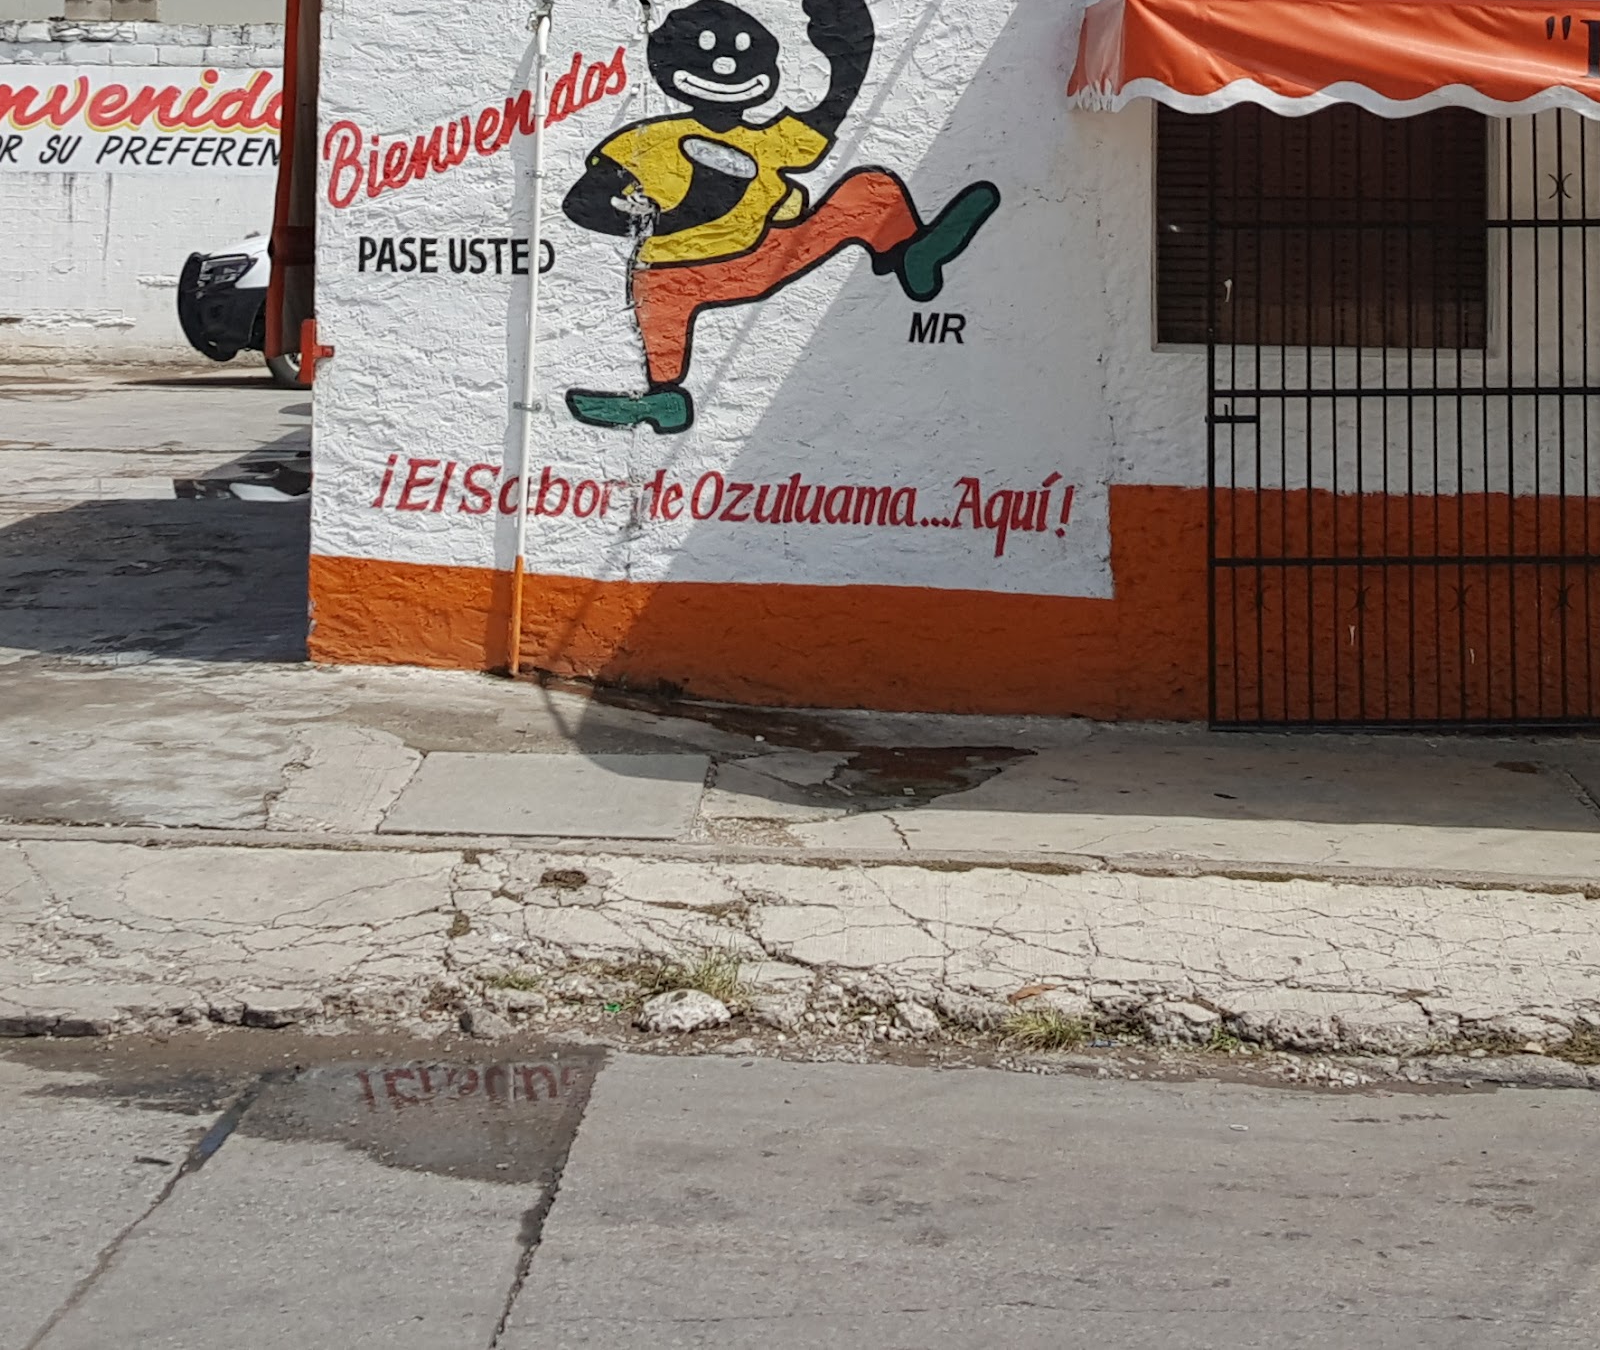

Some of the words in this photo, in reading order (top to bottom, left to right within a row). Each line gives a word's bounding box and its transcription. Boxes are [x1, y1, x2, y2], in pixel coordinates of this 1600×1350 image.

[323, 46, 628, 209] Bienvendos
[38, 135, 83, 165] SU
[357, 236, 438, 273] PASE
[908, 311, 967, 345] MR
